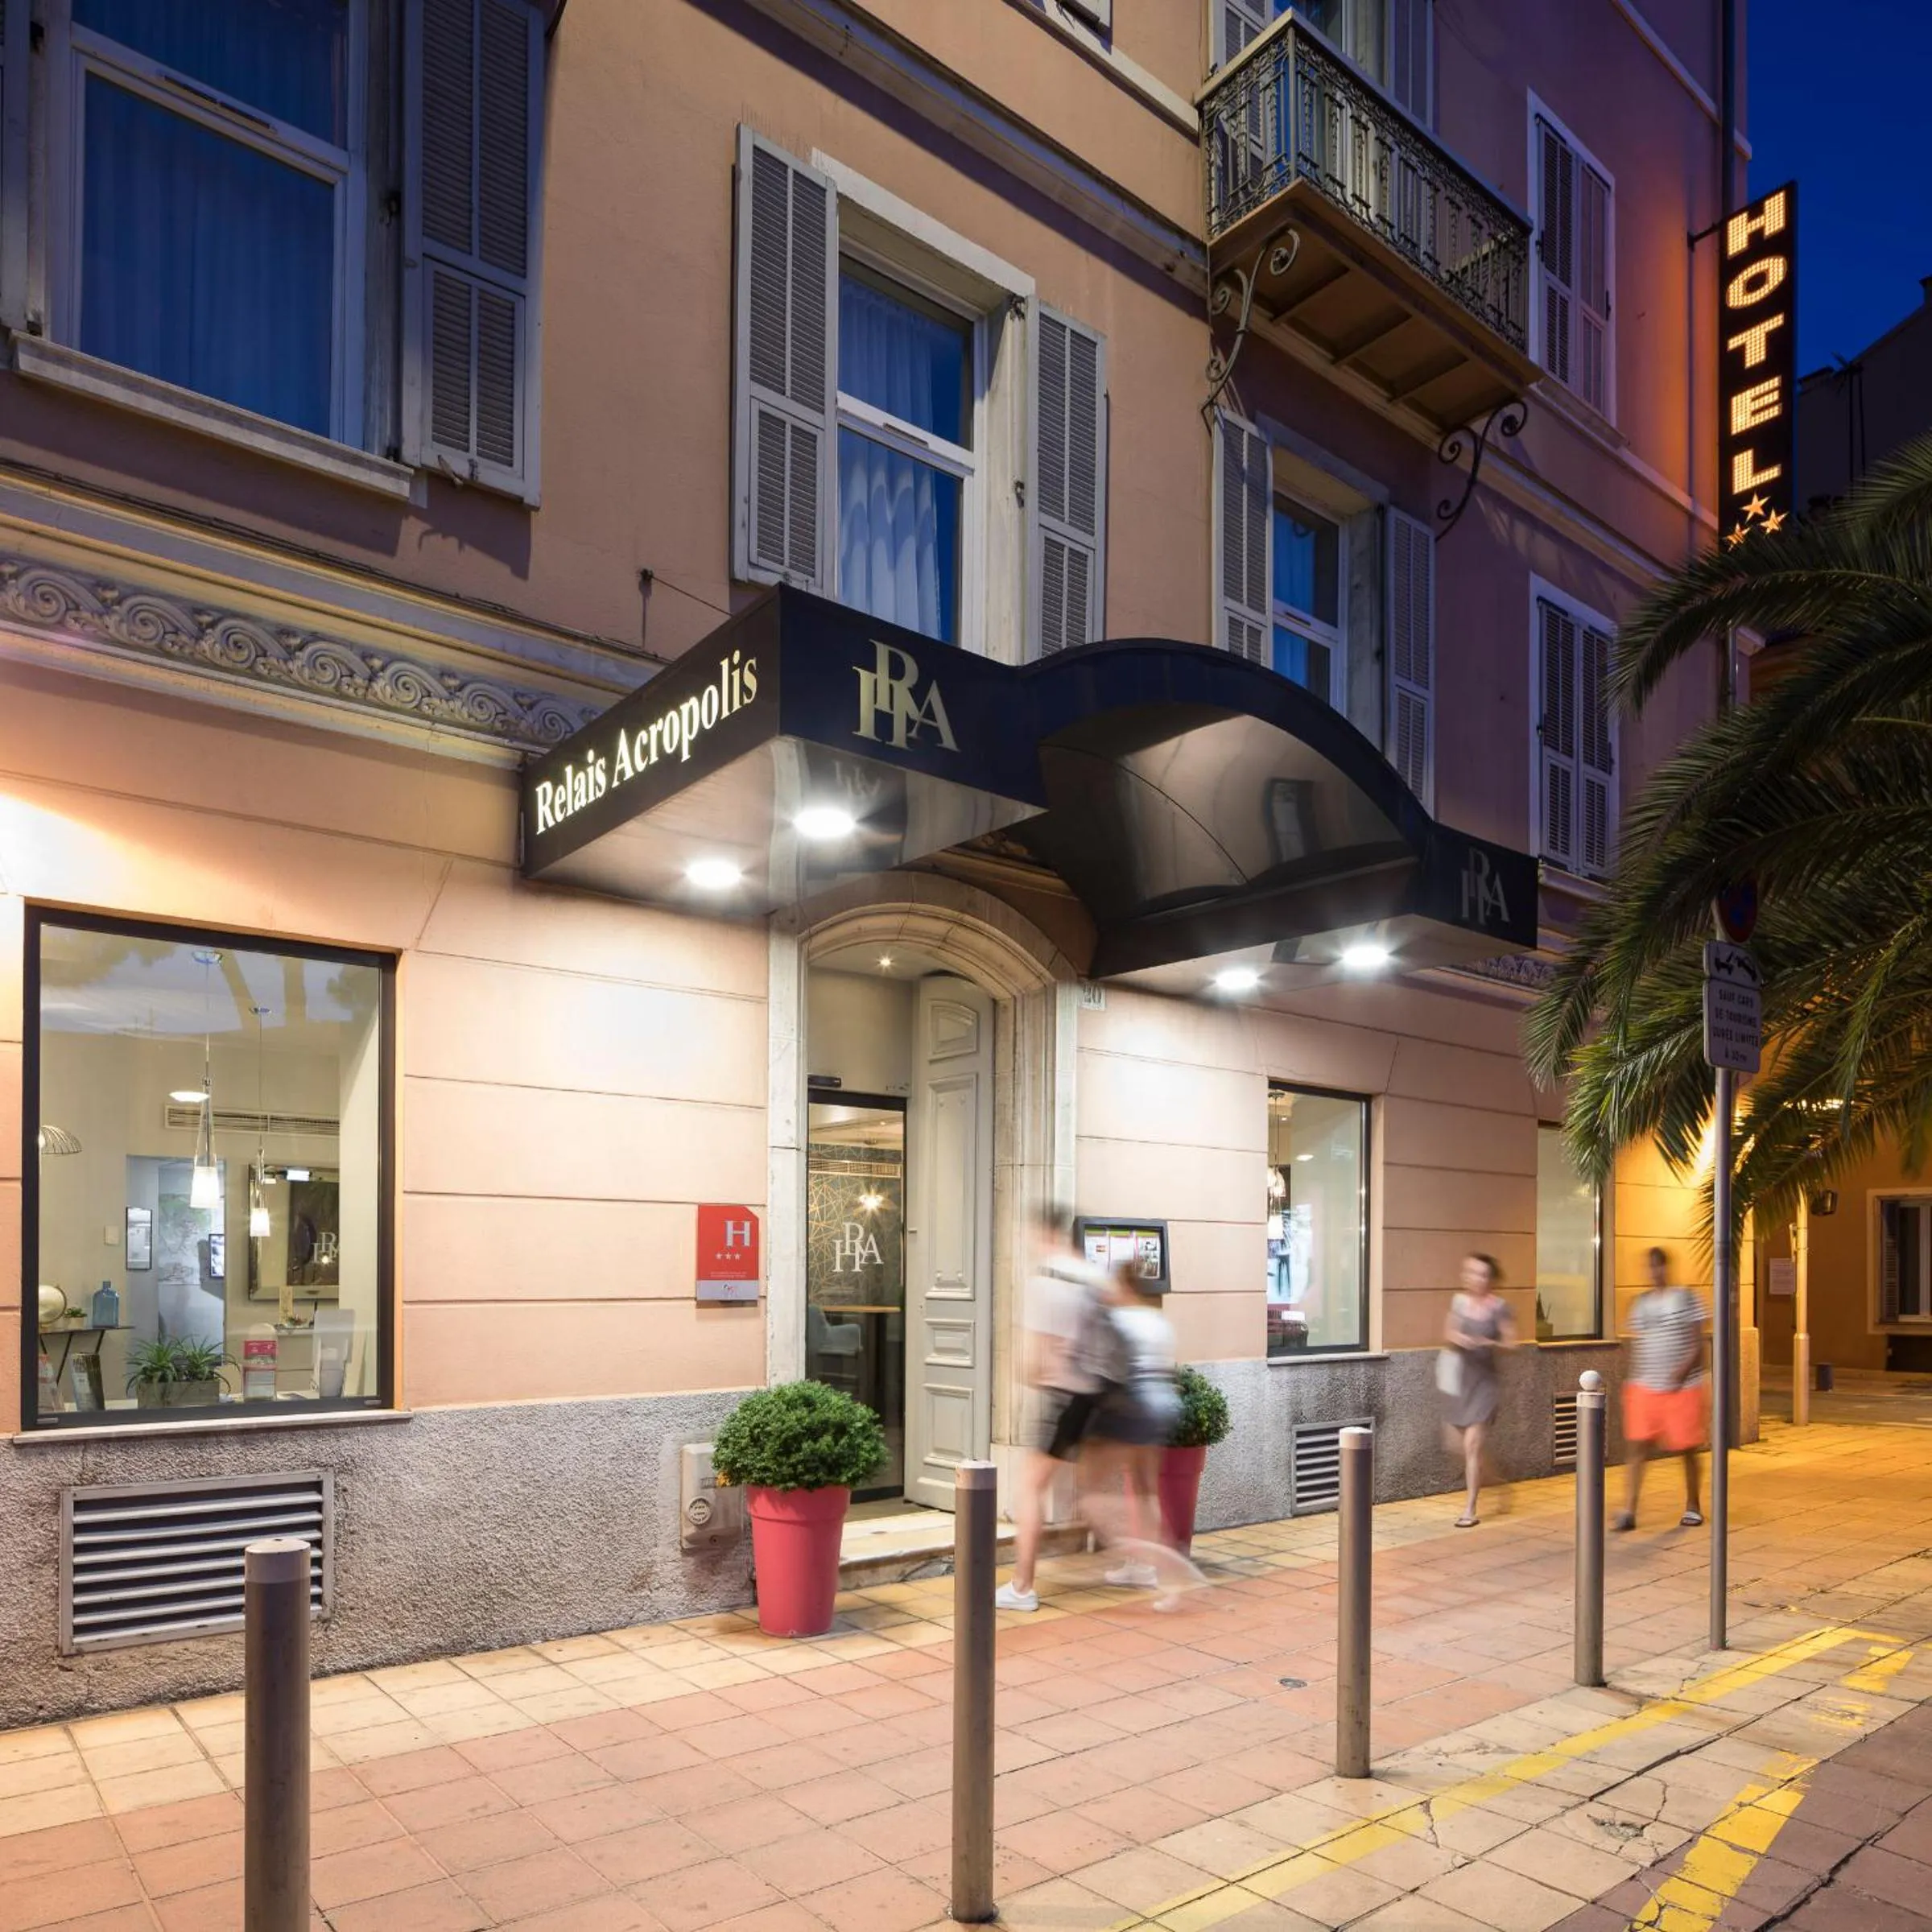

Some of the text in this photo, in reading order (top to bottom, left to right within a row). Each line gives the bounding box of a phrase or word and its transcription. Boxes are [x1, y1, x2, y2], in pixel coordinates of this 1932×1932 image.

[1726, 190, 1786, 495] HOTEL
[535, 650, 758, 835] Relais Acropolis
[726, 1220, 750, 1247] H
